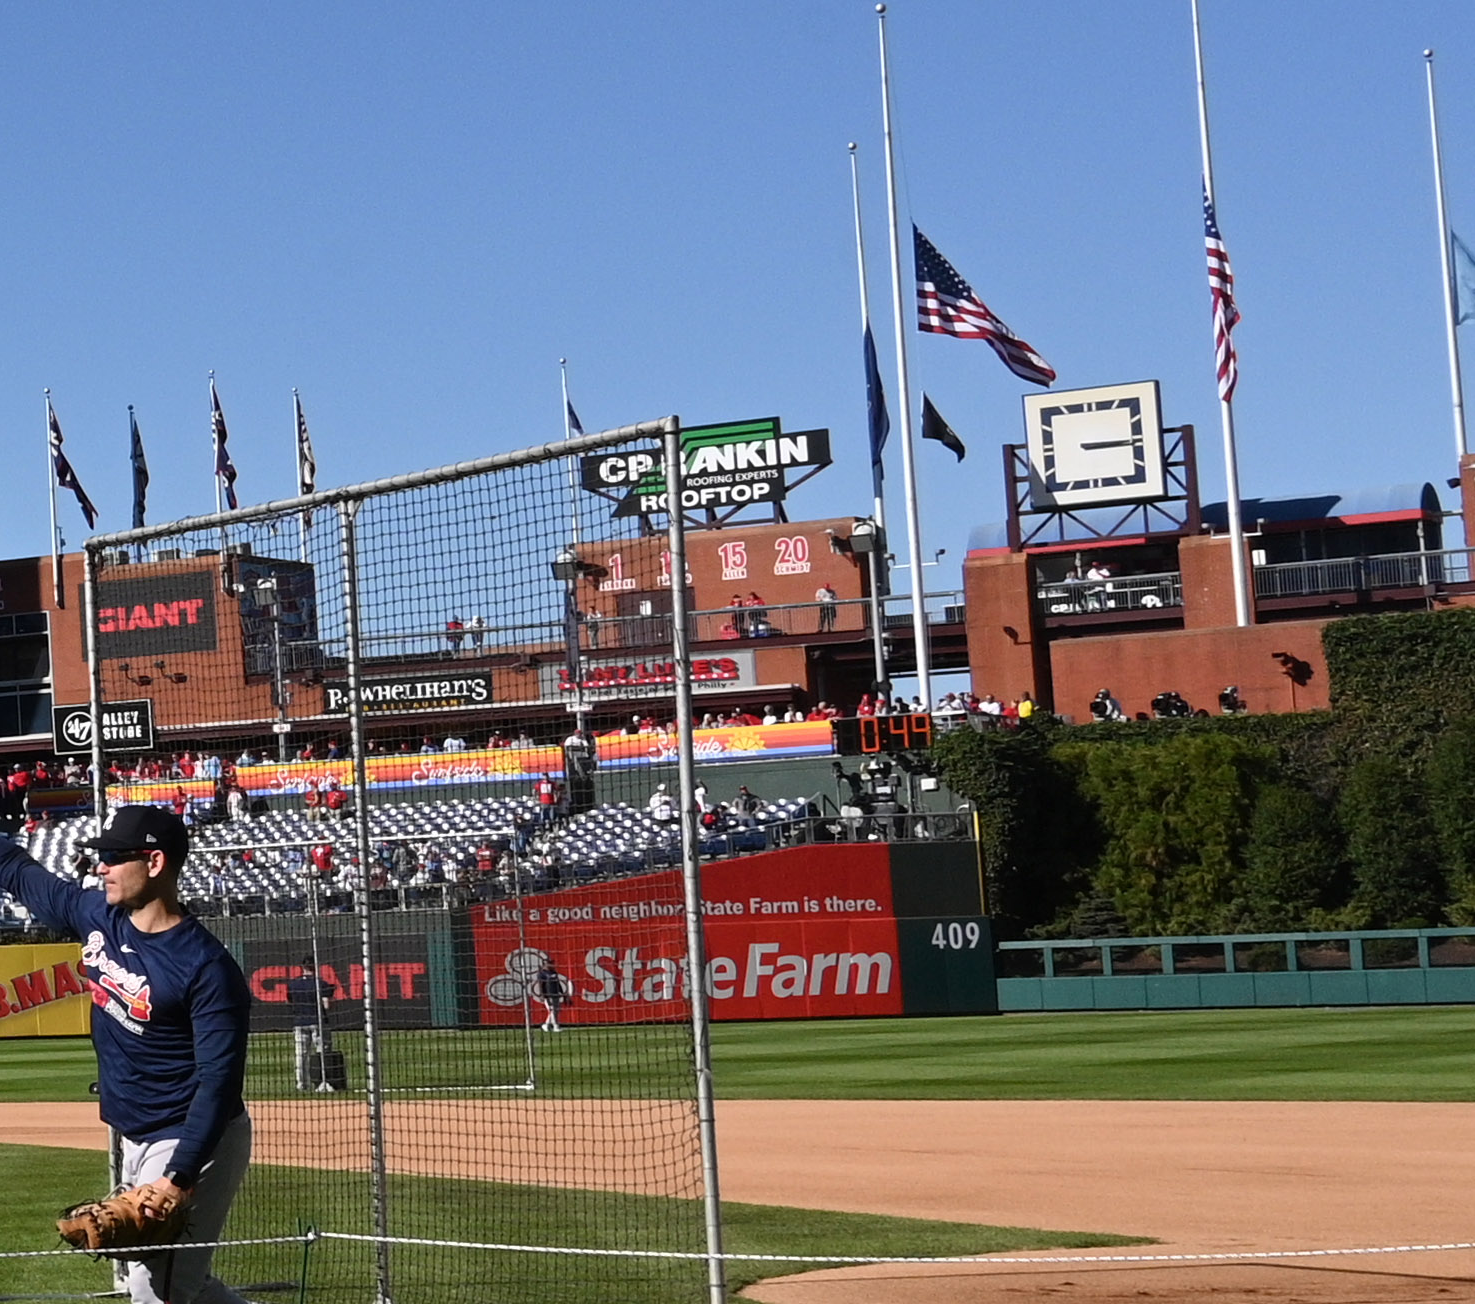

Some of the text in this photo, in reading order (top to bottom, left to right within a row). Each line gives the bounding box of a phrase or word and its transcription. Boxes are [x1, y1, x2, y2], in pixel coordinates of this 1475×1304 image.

[599, 453, 653, 483] CP
[686, 469, 779, 487] ROOFING EXPERTS
[718, 542, 747, 569] 15
[774, 536, 809, 565] 20
[636, 658, 739, 678] LUE'S
[102, 711, 139, 725] ALLEY
[860, 714, 932, 752] 0:49
[485, 903, 522, 923] Like
[529, 909, 540, 921] a
[547, 903, 593, 924] good
[750, 896, 799, 915] Farm
[804, 896, 820, 913] is
[825, 895, 883, 913] there.
[931, 921, 981, 951] 409
